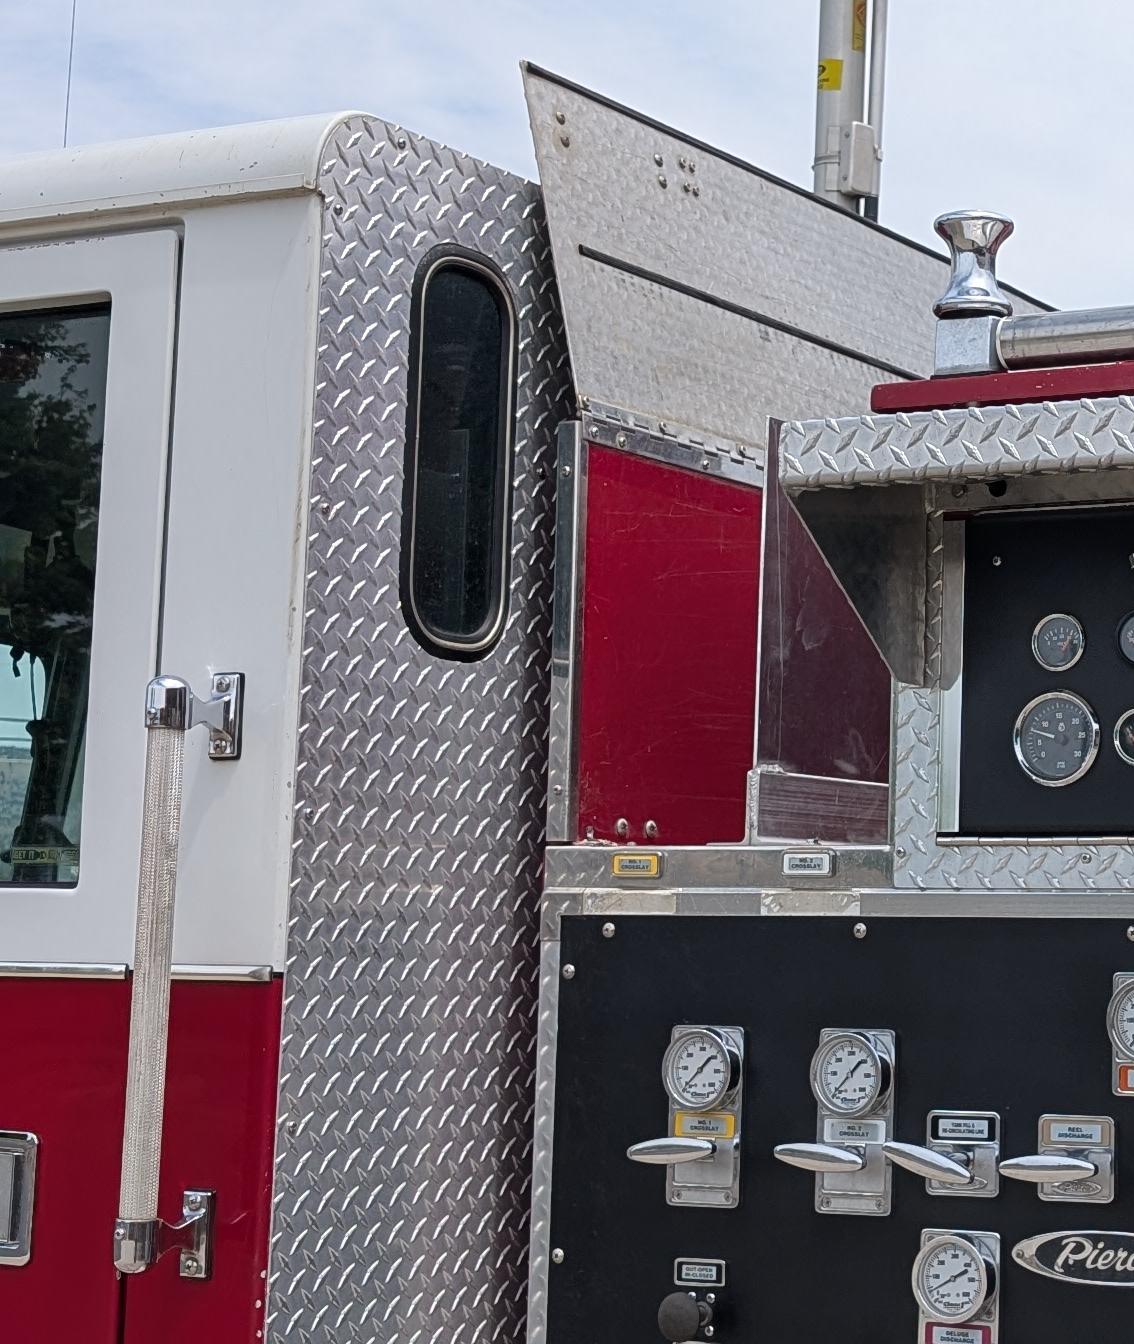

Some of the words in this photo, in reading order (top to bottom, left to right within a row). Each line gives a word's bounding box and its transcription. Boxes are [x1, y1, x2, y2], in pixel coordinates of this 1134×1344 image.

[1041, 720, 1049, 728] 10
[1078, 731, 1086, 739] 25
[940, 1336, 974, 1344] DISCHARGE
